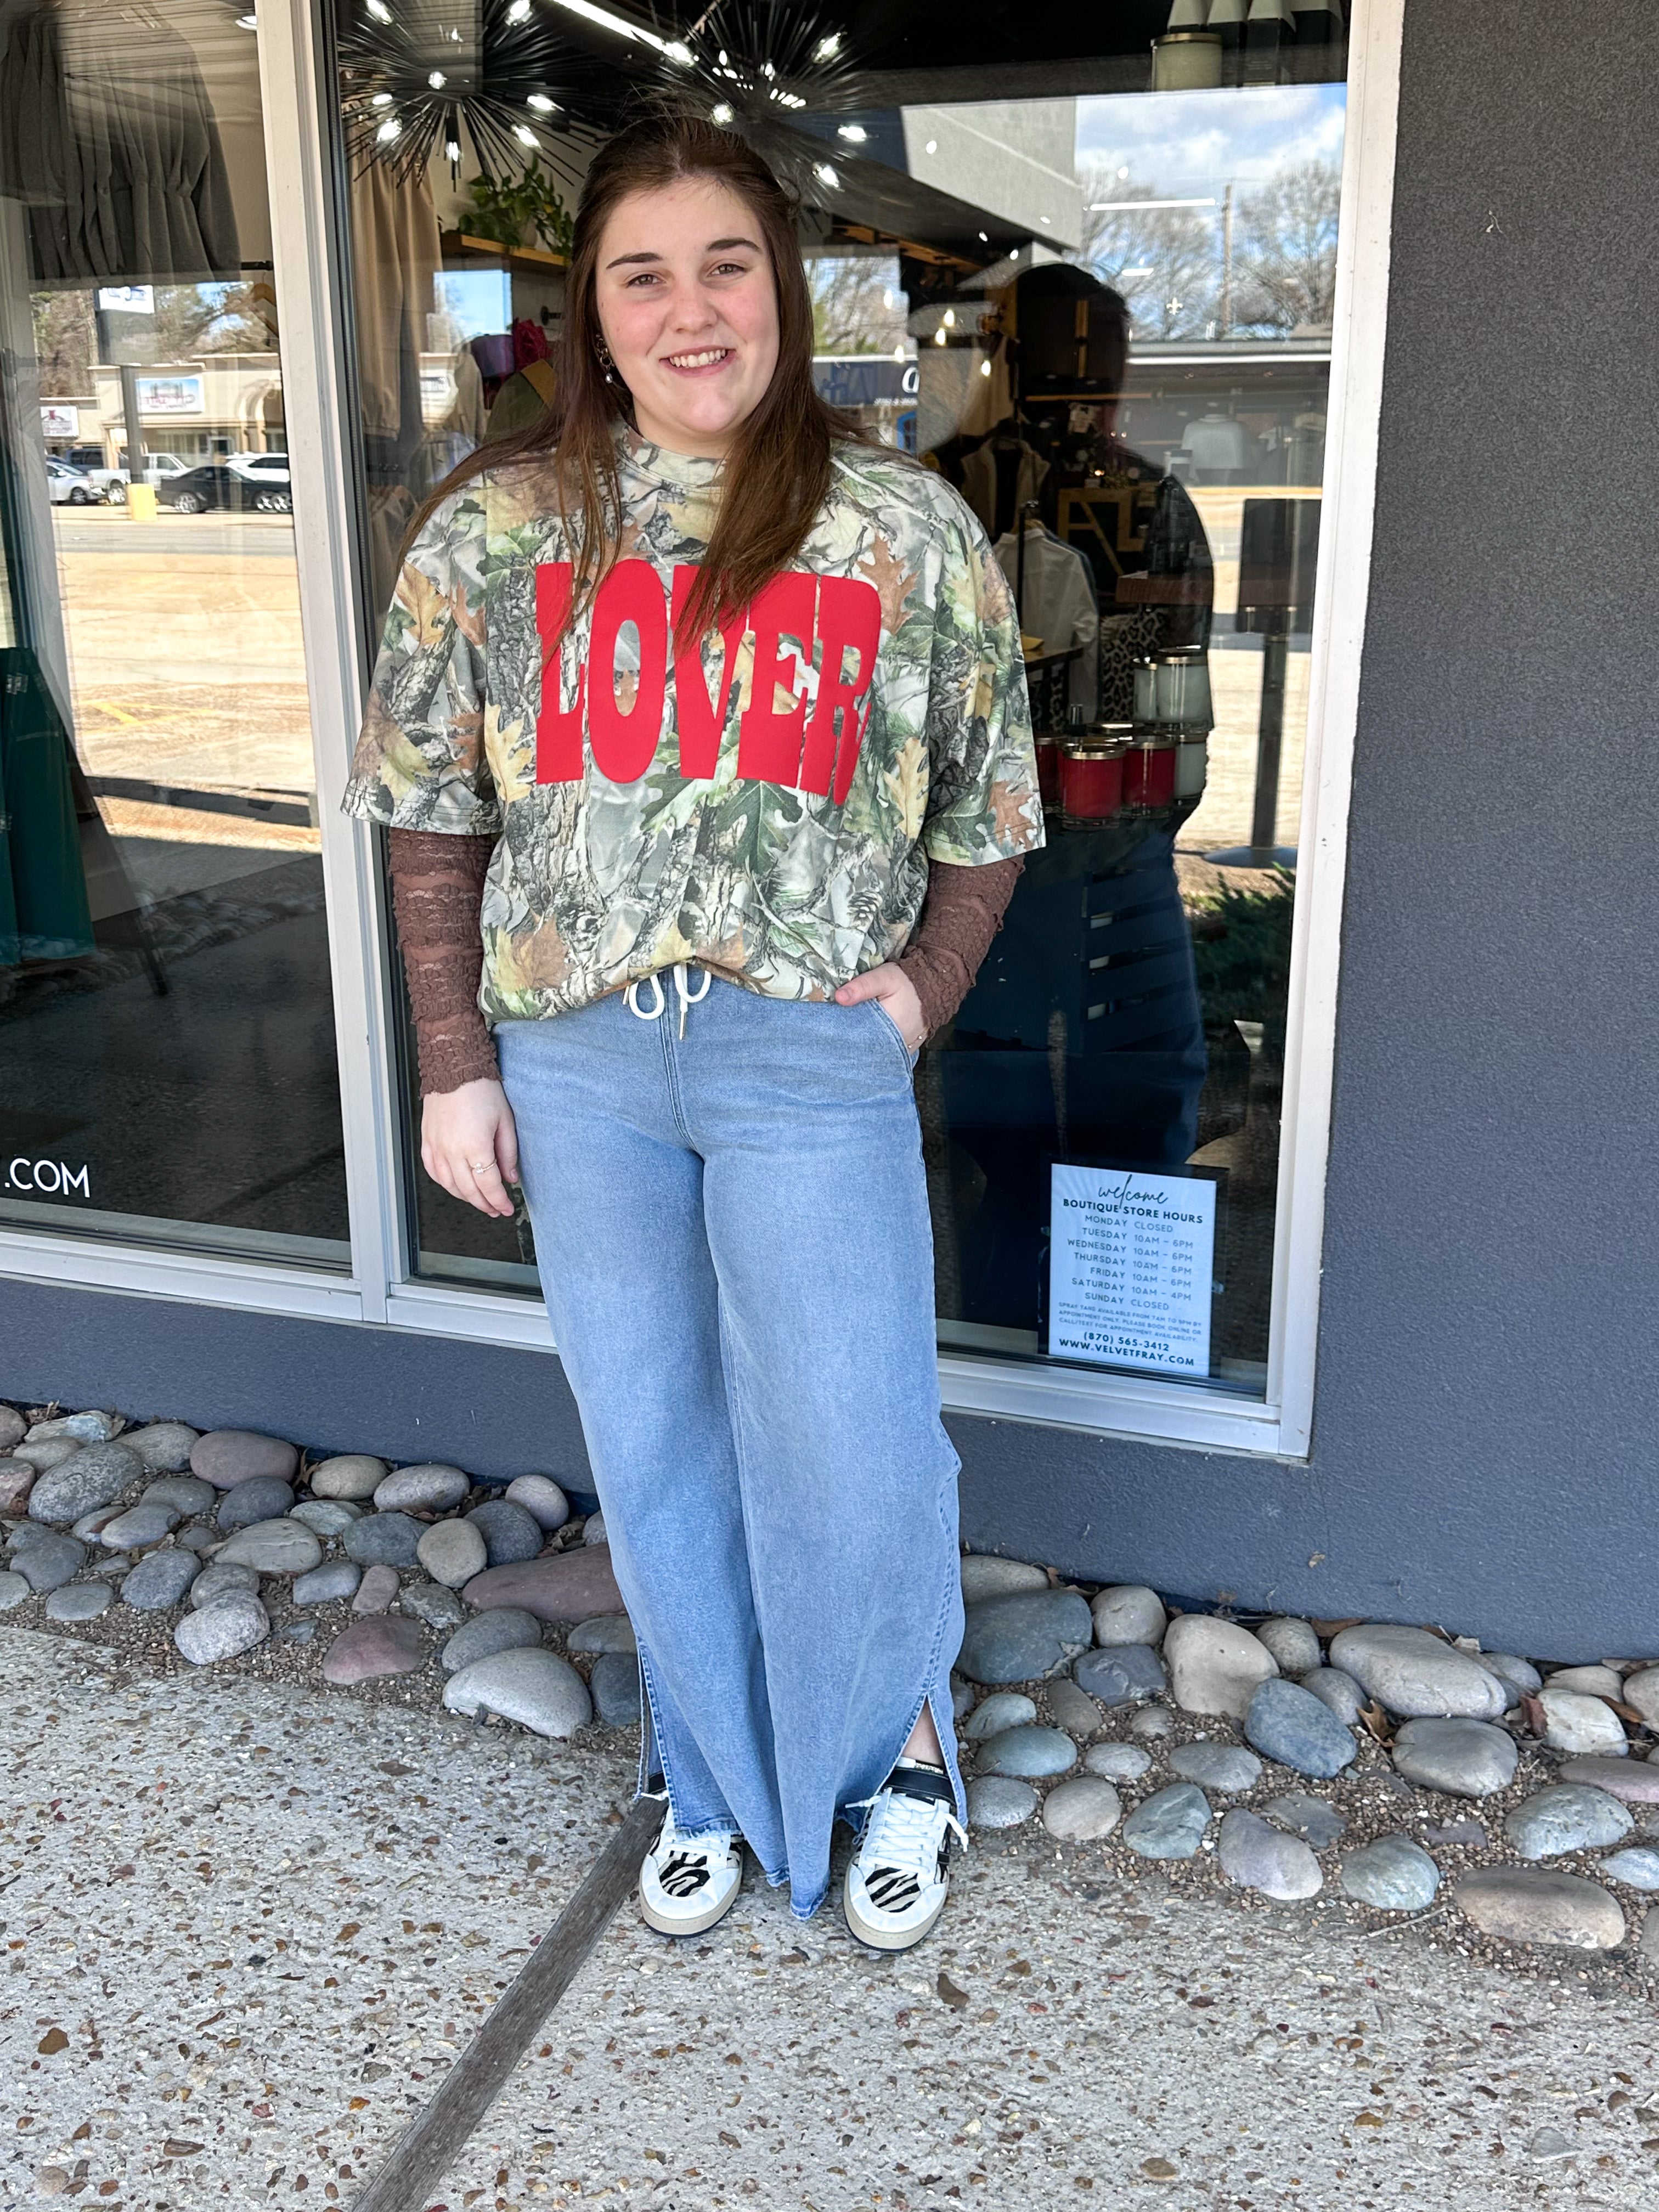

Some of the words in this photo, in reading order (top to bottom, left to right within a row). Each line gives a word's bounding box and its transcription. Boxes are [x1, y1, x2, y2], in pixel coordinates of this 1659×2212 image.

[536, 558, 881, 805] LOVER
[4, 1158, 90, 1198] .COM
[1098, 1174, 1169, 1209] welcome
[1063, 1199, 1119, 1212] BOUTIQUE
[1124, 1206, 1159, 1218] STORE
[1163, 1211, 1203, 1223] HOURS
[1085, 1215, 1127, 1227] MONDAY
[1135, 1221, 1173, 1233] CLOSED
[1083, 1227, 1127, 1239] TUESDAY
[1135, 1234, 1159, 1244] 10AM
[1173, 1239, 1193, 1248] 6PM
[1068, 1239, 1126, 1253] WEDNESDAY
[1133, 1248, 1159, 1256] 10AM
[1172, 1252, 1192, 1262] 6PM
[1074, 1252, 1126, 1266] THURSDAY
[1133, 1260, 1158, 1269] 10AM
[1171, 1266, 1192, 1274] 6PM
[1090, 1267, 1125, 1279] FRIDAY
[1132, 1273, 1158, 1282] 10AM
[1171, 1279, 1191, 1288] 6PM
[1071, 1277, 1125, 1291] SATURDAY
[1132, 1286, 1157, 1295] 10AM
[1171, 1292, 1191, 1301] 4PM
[1085, 1293, 1124, 1304] SUNDAY
[1131, 1299, 1169, 1310] CLOSED
[1098, 1308, 1130, 1317] AVAILABLE
[1059, 1310, 1101, 1320] APPOINTMENT
[1122, 1318, 1146, 1327] PLEASE
[1168, 1325, 1190, 1334] ONLINE
[1110, 1325, 1152, 1335] APPOINTMENT
[1059, 1338, 1194, 1365] WWW.VELVETFRAY.COM
[1084, 1331, 1114, 1344] (870)
[1118, 1336, 1169, 1351] 565-3412
